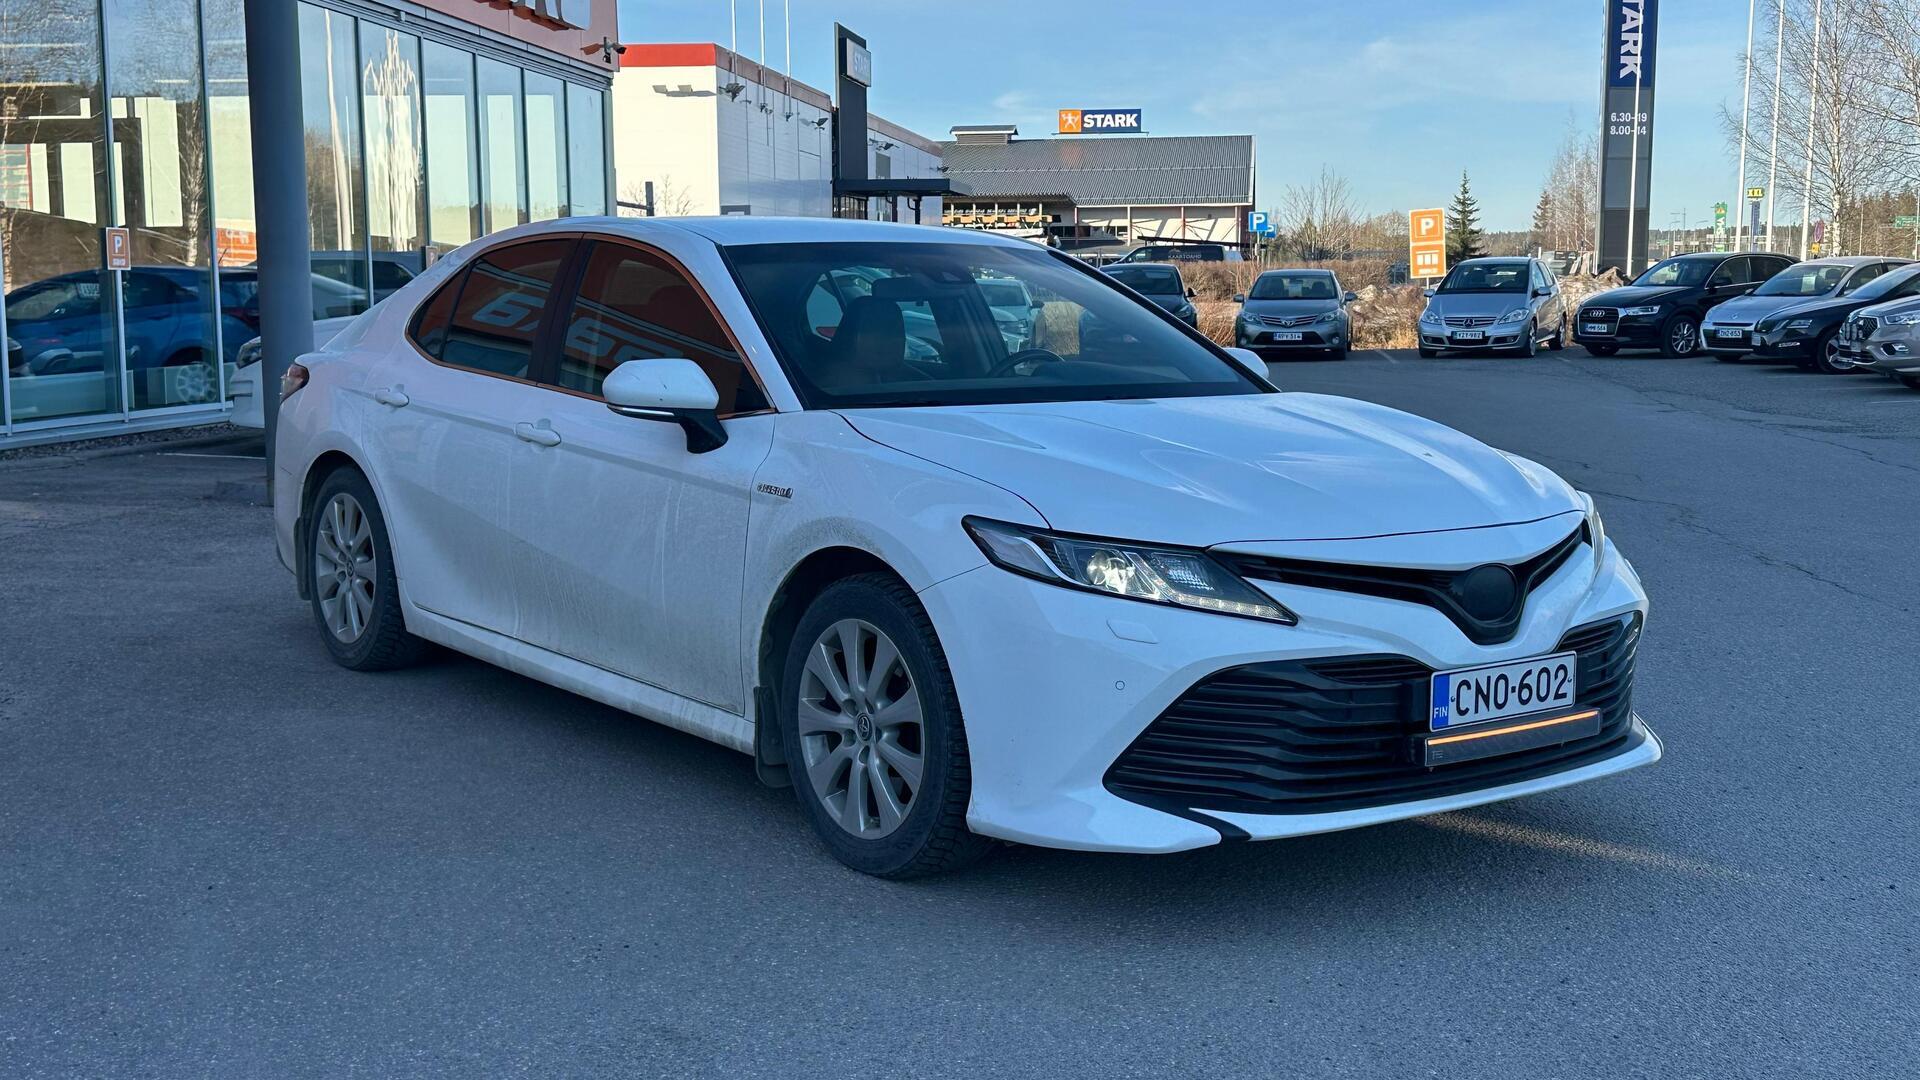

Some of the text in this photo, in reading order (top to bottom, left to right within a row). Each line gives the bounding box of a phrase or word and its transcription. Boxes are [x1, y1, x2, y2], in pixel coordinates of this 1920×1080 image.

[1083, 113, 1138, 128] STARK
[1747, 188, 1764, 198] XXL
[1253, 213, 1265, 230] P
[1420, 217, 1435, 236] P
[113, 235, 123, 254] P
[1455, 663, 1569, 717] CNO-602
[1433, 705, 1449, 719] FIN
